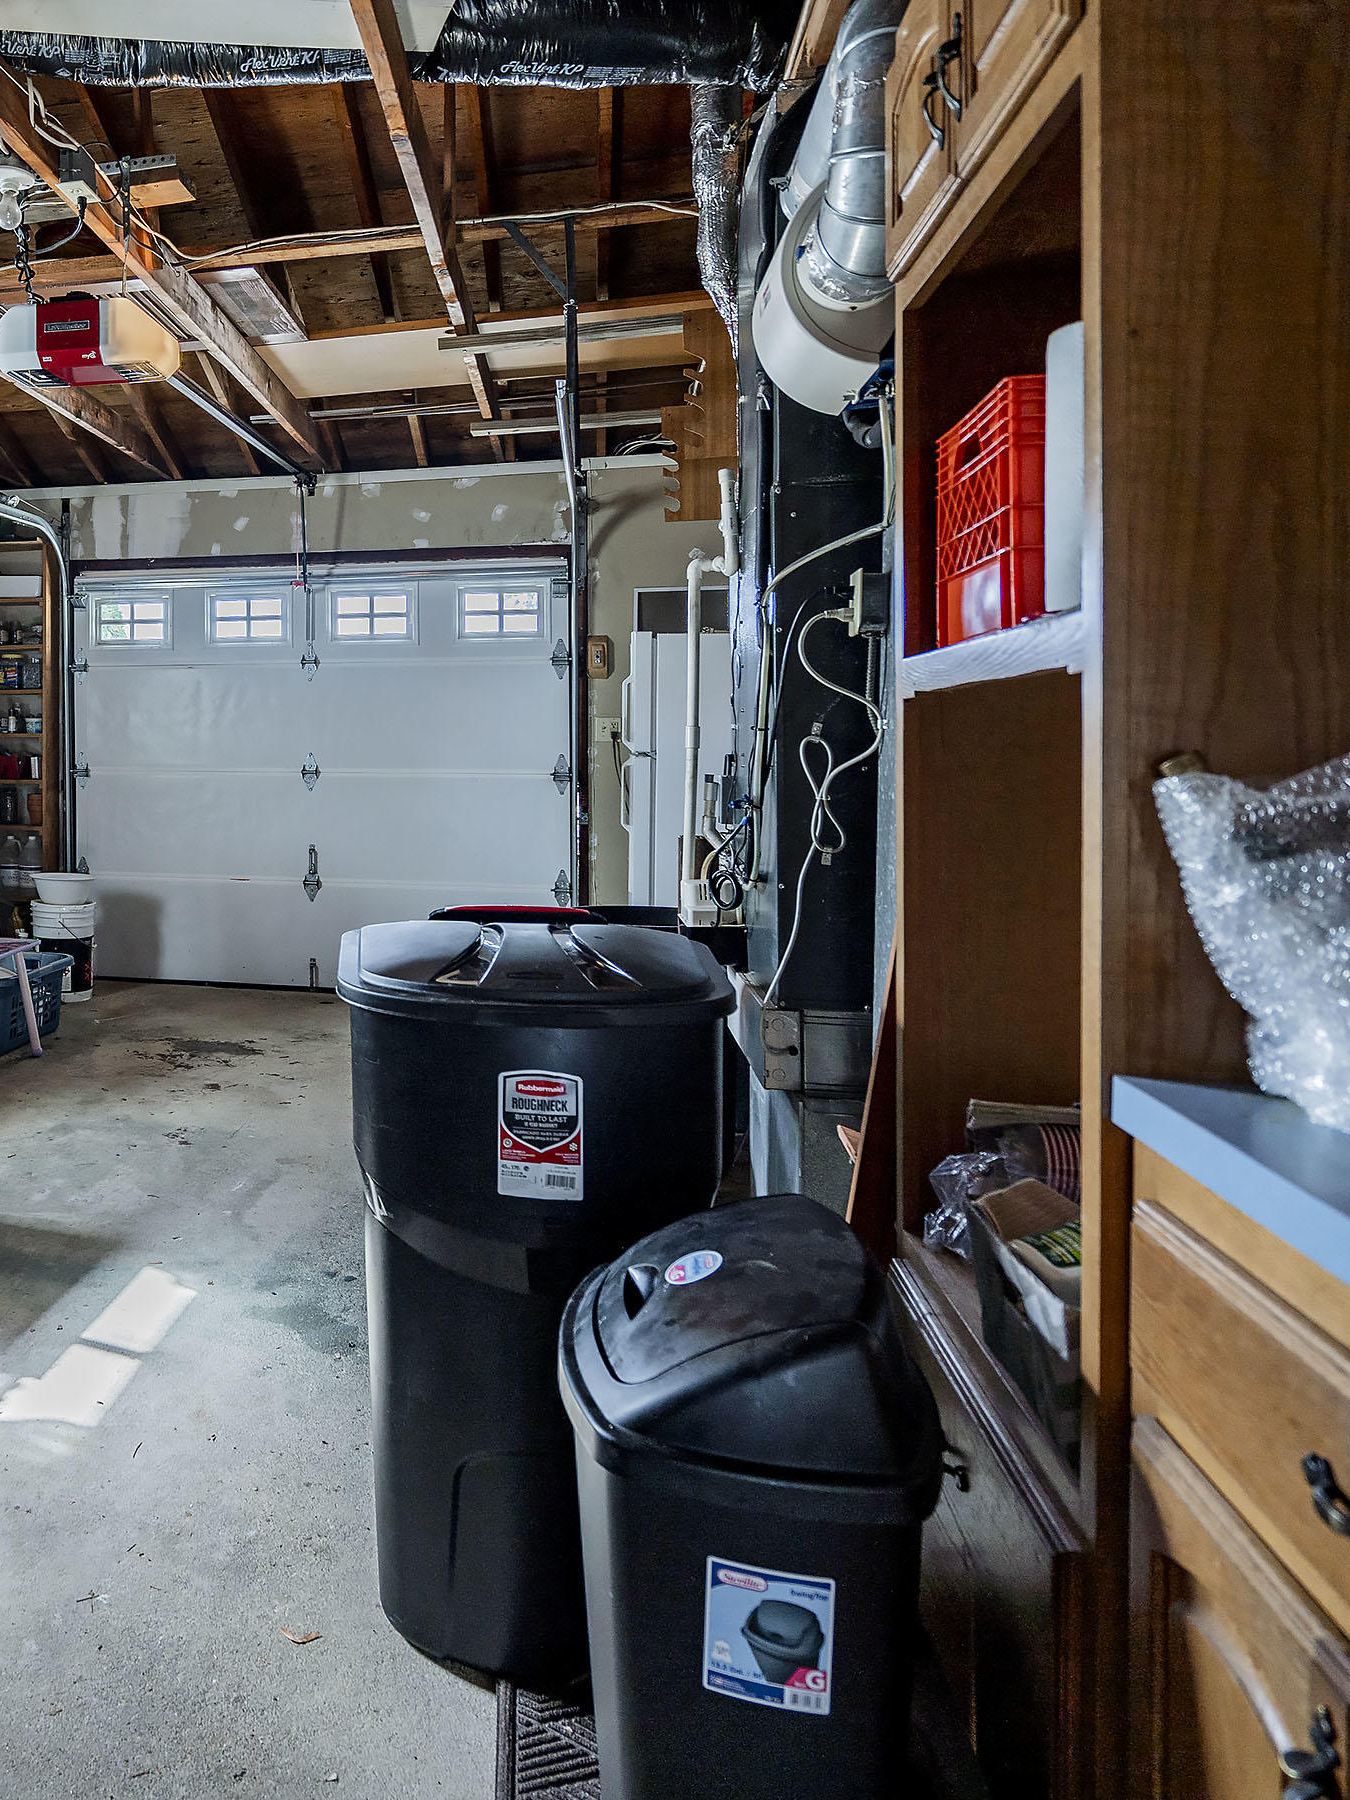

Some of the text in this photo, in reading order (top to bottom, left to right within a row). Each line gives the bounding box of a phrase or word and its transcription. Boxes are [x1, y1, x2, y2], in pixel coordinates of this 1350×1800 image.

[500, 60, 531, 73] Flex
[560, 63, 584, 75] KP
[517, 1084, 564, 1093] Rubbermaid
[512, 1097, 568, 1112] ROUGHNECK
[805, 1670, 825, 1690] G
